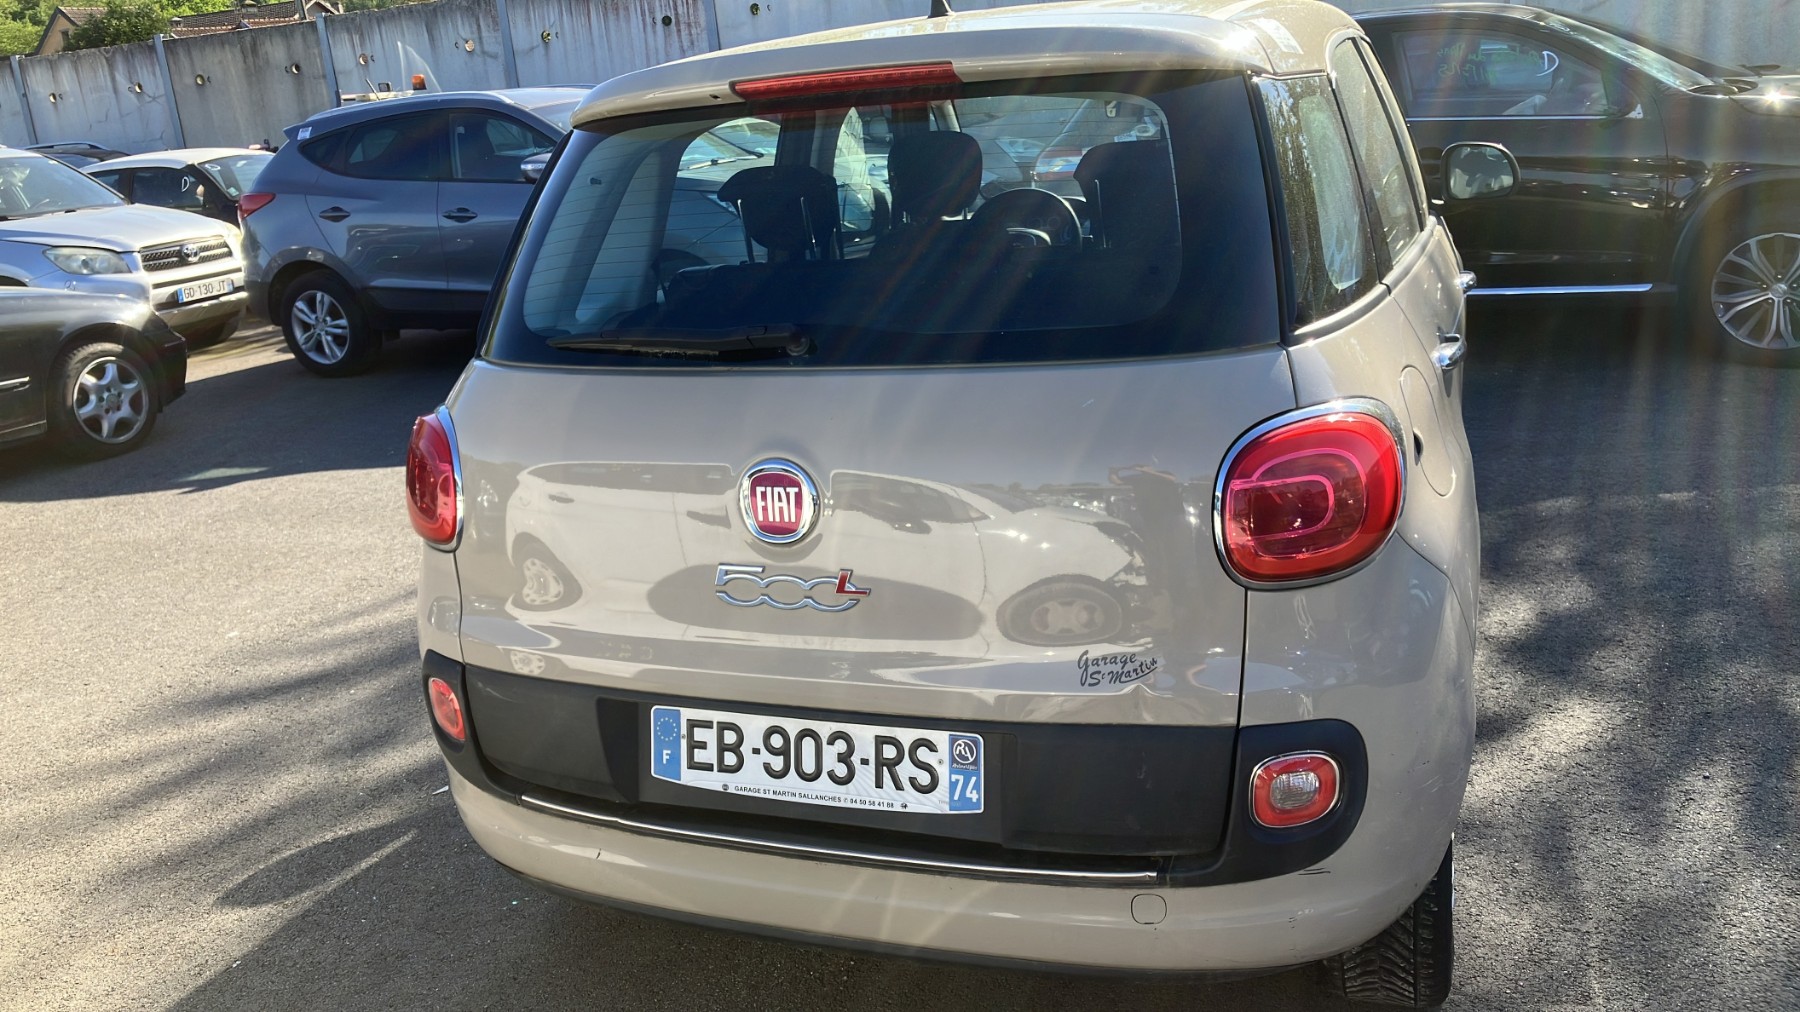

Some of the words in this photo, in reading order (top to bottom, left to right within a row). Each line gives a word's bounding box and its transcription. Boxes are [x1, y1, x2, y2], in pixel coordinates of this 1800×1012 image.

[756, 486, 799, 522] FIAT
[1077, 649, 1137, 687] Garage
[1108, 657, 1158, 684] Martin
[662, 750, 671, 764] F
[686, 719, 940, 794] EB-903-RS
[734, 785, 761, 795] GARAGE
[773, 789, 797, 798] MARTIN
[798, 792, 842, 803] SALLANCHES
[951, 774, 979, 803] 74
